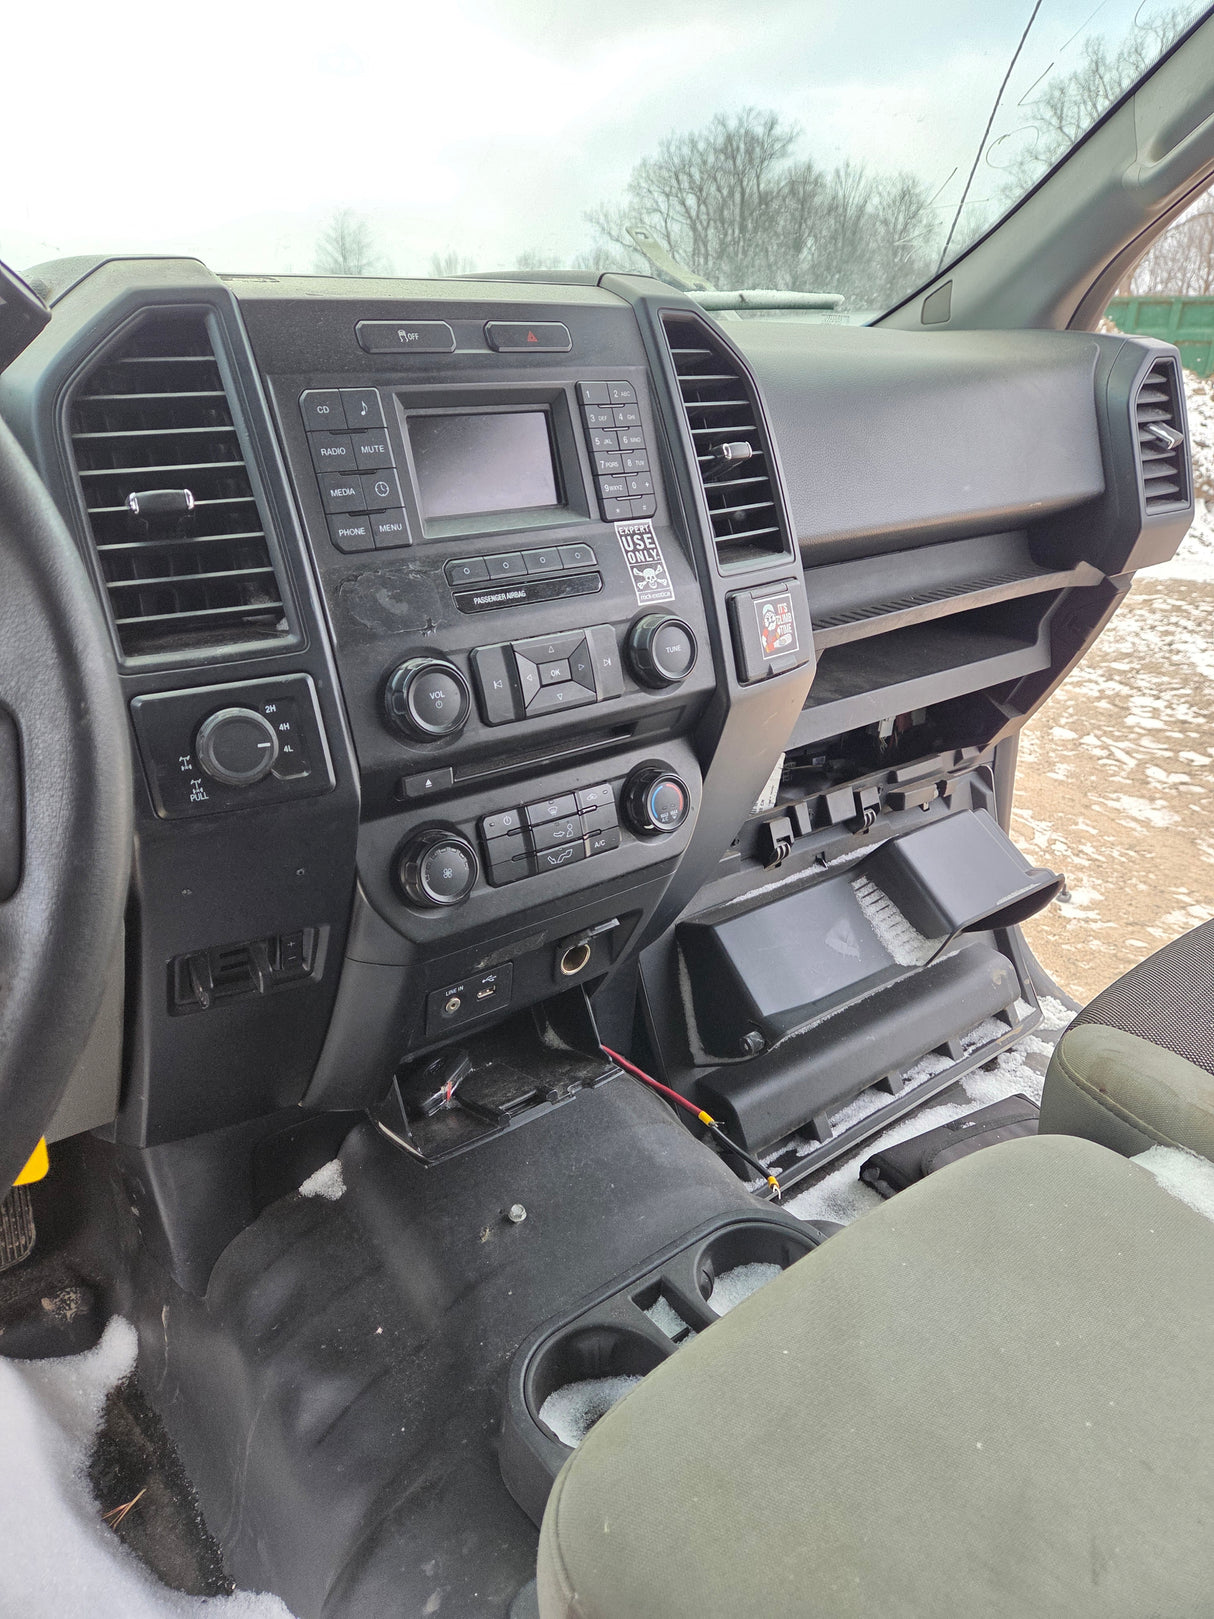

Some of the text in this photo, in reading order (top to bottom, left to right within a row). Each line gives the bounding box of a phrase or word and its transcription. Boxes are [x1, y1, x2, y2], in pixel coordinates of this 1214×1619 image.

[407, 332, 420, 341] OFF
[586, 390, 591, 399] 1
[613, 389, 619, 398] 2
[316, 406, 330, 414] CD
[590, 414, 596, 422] 3
[618, 413, 624, 421] 4
[595, 437, 600, 445] 5
[623, 436, 629, 444] 6
[320, 447, 346, 456] RADIO
[361, 445, 385, 454] MUTE
[600, 460, 605, 469] 7
[627, 459, 633, 467] 8
[330, 487, 356, 497] MEDIA
[604, 484, 610, 492] 9
[338, 527, 366, 537] PHONE
[379, 523, 403, 533] MENU
[618, 525, 649, 535] EXPERT
[621, 533, 655, 551] USE
[473, 590, 527, 605] PASSENGER AIRBAG
[665, 644, 681, 653] TUNE
[550, 668, 561, 677] OK
[429, 690, 446, 700] VOL
[265, 704, 277, 714] 2H
[279, 722, 290, 731] 4H
[283, 745, 294, 753] 4L
[190, 791, 209, 802] PULL
[594, 839, 606, 848] A/C
